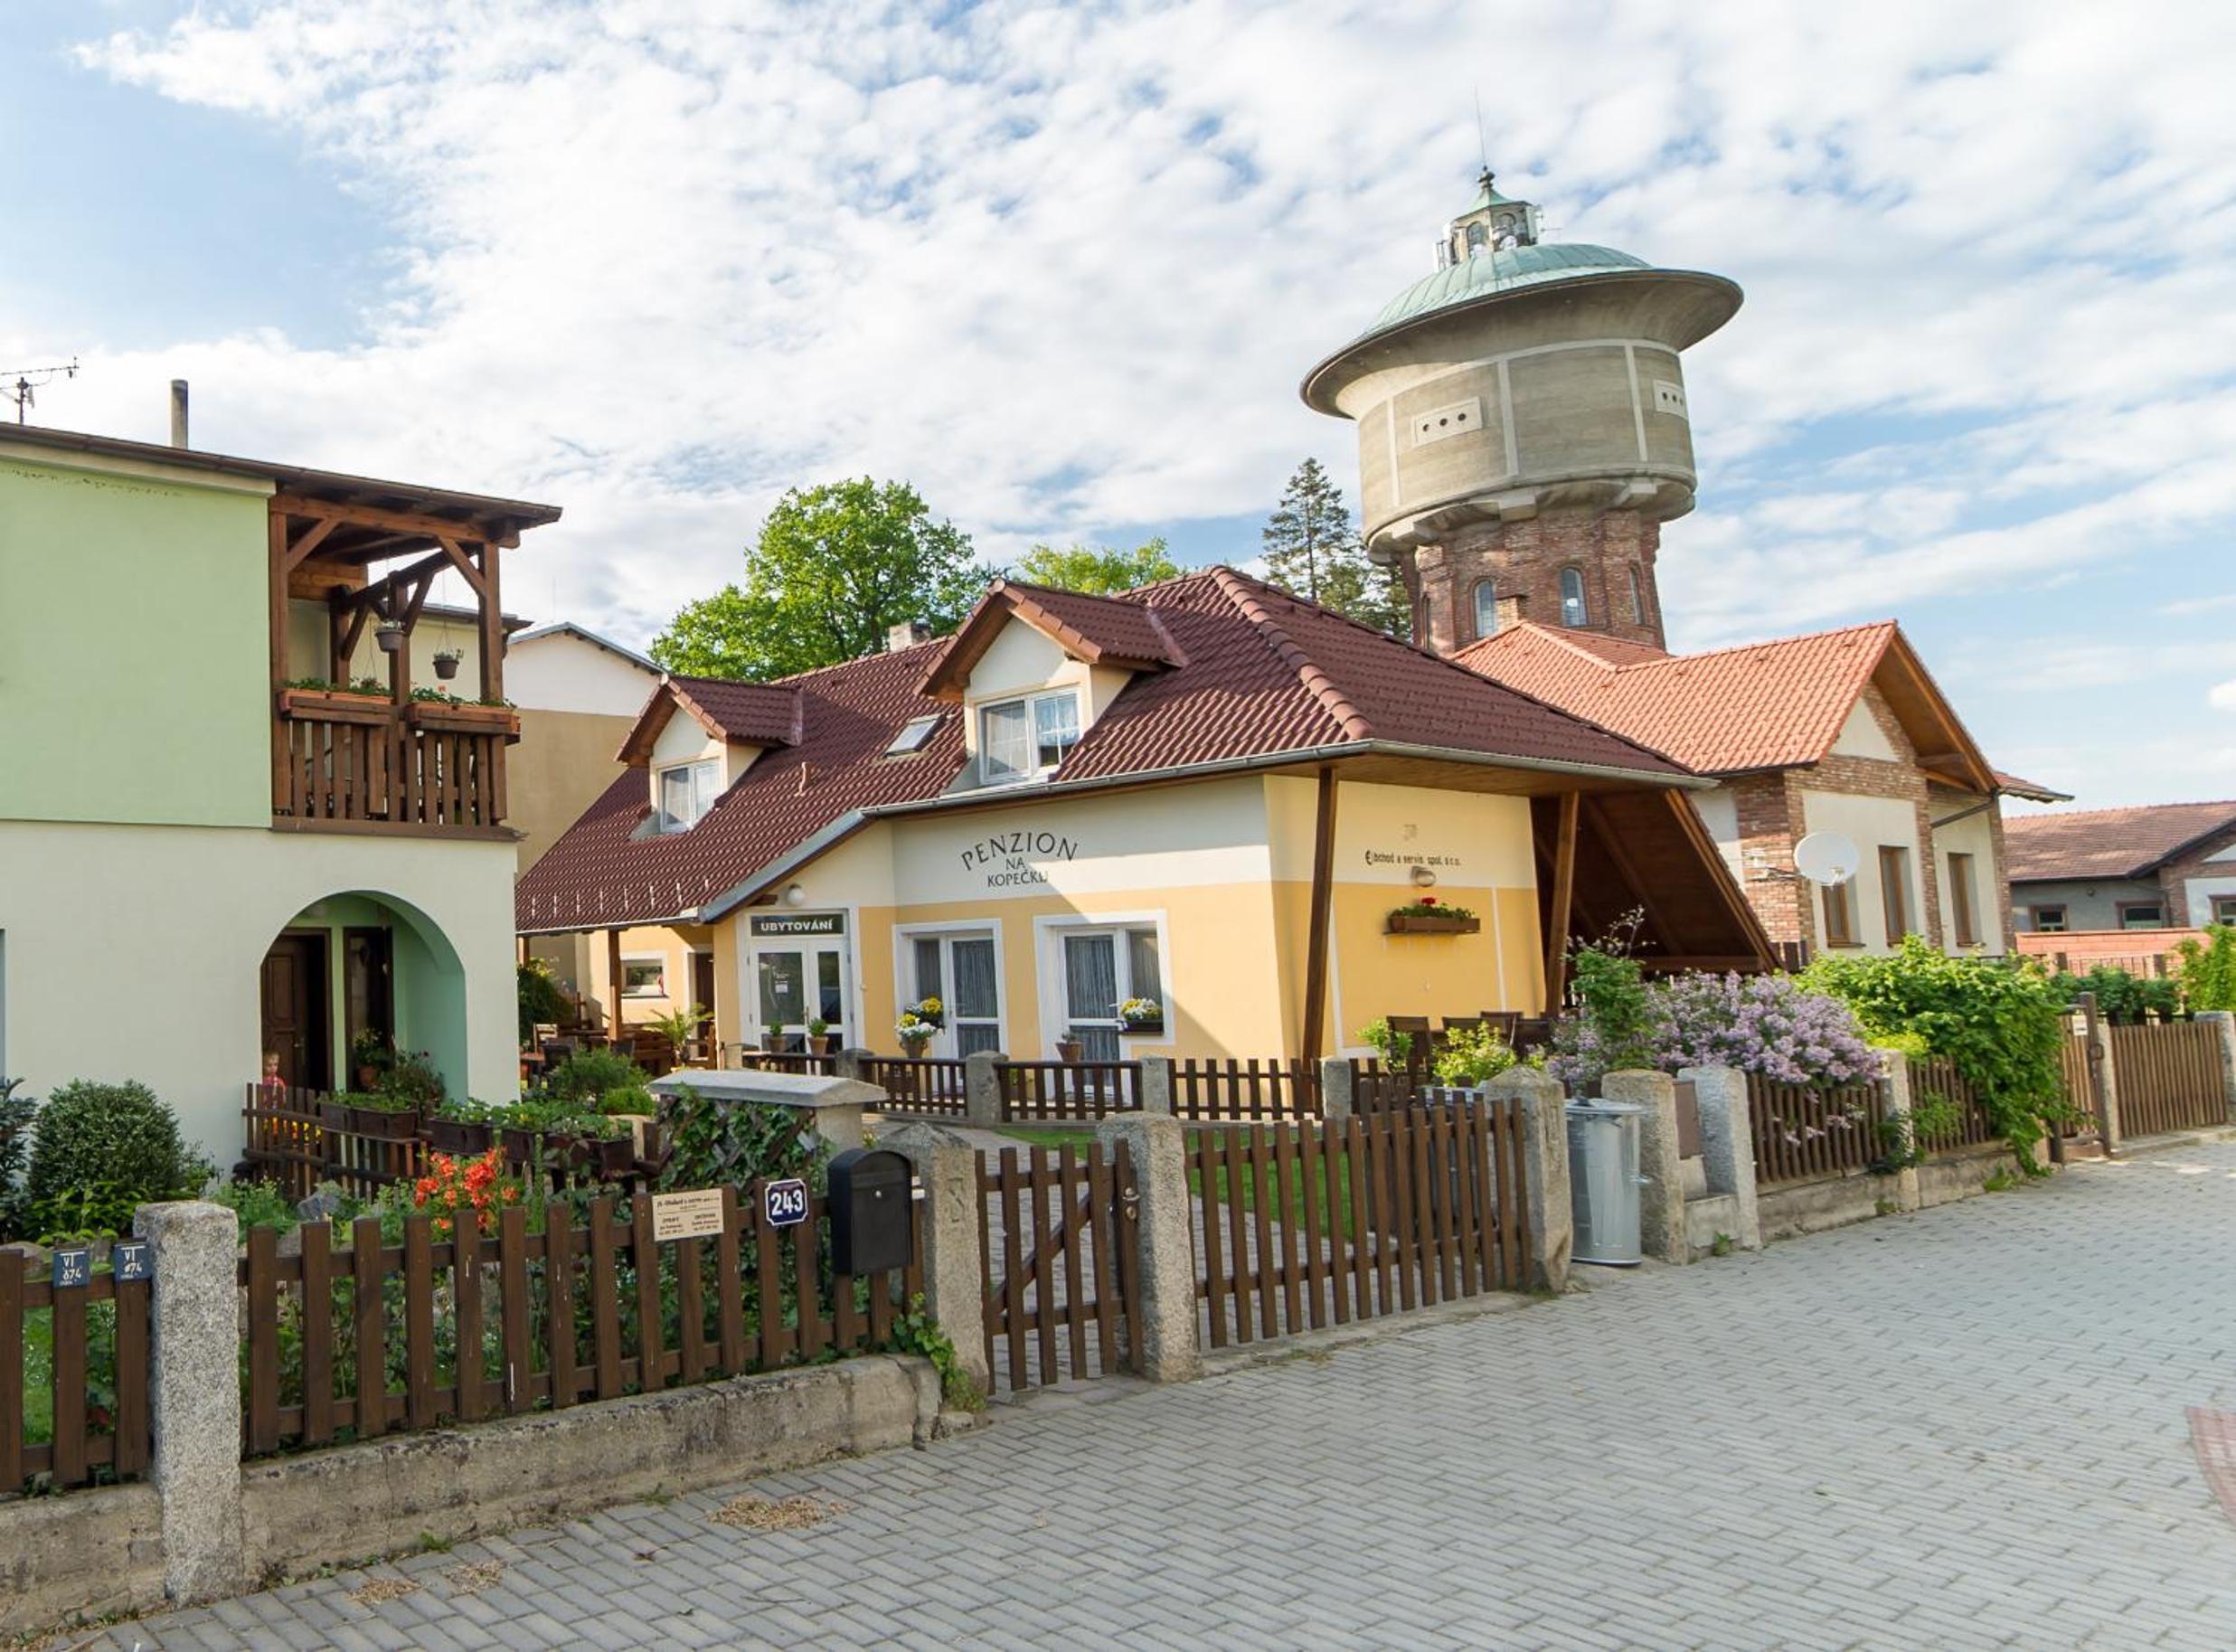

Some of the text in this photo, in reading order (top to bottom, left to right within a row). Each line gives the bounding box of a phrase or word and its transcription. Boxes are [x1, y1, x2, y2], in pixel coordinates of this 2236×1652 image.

[960, 832, 1078, 871] PENZION
[1005, 857, 1025, 870] NA
[987, 869, 1049, 887] KOPEČKU
[760, 919, 834, 931] UBYTOVÁNÍ
[769, 1189, 803, 1216] 243
